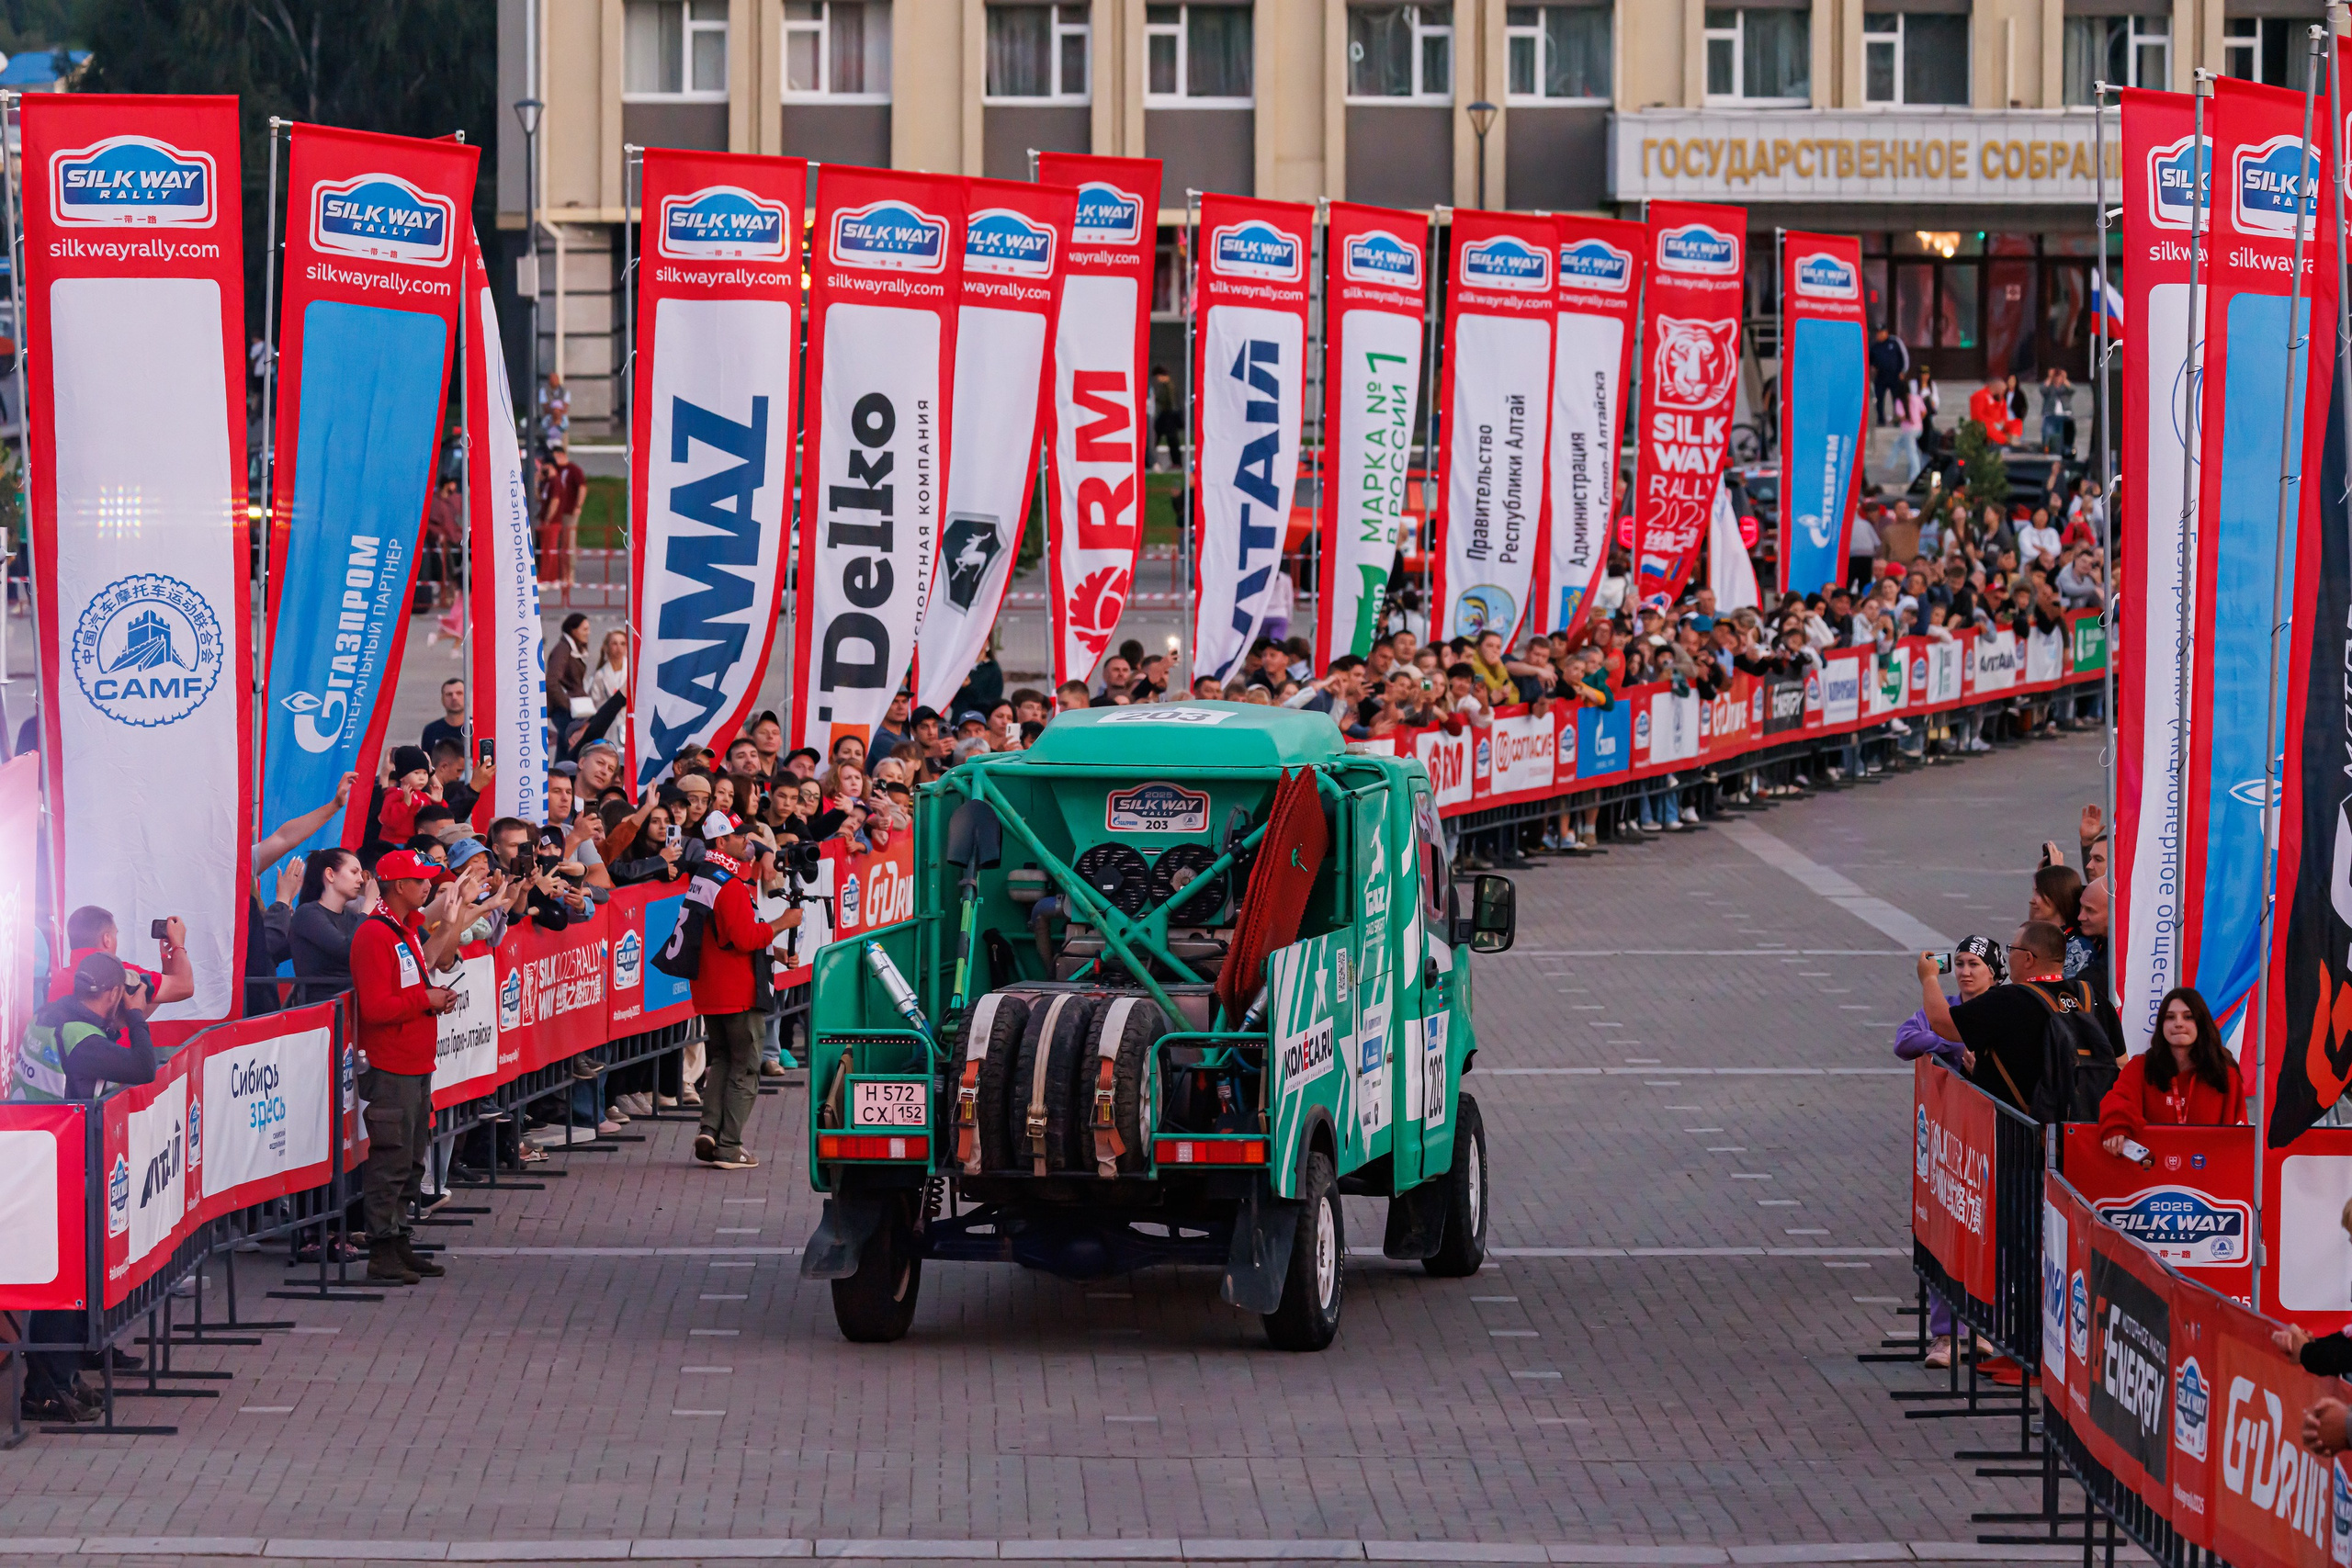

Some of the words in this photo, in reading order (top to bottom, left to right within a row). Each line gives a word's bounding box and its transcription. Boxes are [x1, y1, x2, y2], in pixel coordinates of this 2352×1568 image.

[1643, 138, 1968, 185] ГОСУДАРСТВЕННОЕ
[66, 170, 135, 188] SILK
[141, 170, 200, 189] WAY
[2245, 169, 2300, 195] SILK
[100, 190, 170, 199] RALLY
[113, 215, 157, 224] 一带一路
[325, 199, 385, 222] SILK
[389, 208, 440, 229] WAY
[671, 212, 727, 229] SILK
[731, 214, 777, 231] WAY
[1099, 205, 1134, 220] WAY
[353, 222, 411, 237] RALLY
[696, 229, 754, 239] RALLY
[842, 223, 893, 241] SILK
[896, 226, 937, 243] WAY
[967, 230, 1004, 247] ILK
[1006, 234, 1046, 251] WAY
[50, 239, 220, 261] silkwayrally.com
[865, 241, 914, 251] RALLY
[1222, 238, 1259, 253] SILK
[1261, 243, 1292, 258] WAY
[1352, 246, 1385, 261] SILK
[1385, 251, 1413, 265] WAY
[1667, 240, 1699, 253] SILK
[1701, 242, 1729, 255] WAY
[1069, 251, 1140, 266] wayrally.com
[1470, 253, 1504, 266] SILK
[1508, 256, 1543, 270] WAY
[1561, 254, 1590, 267] SILK
[1592, 258, 1623, 272] WAY
[306, 263, 450, 296] silkwayrally.com
[656, 267, 791, 287] silkwayrally.com
[827, 274, 944, 296] silkwayrally.com
[961, 281, 1051, 300] wayrally.com
[1209, 280, 1303, 301] silkwayrally.com
[1342, 287, 1423, 308] silkwayrally.com
[1457, 291, 1553, 310] silkwayrally.com
[1505, 395, 1525, 449] Алтай
[1653, 412, 1727, 445] SILK
[917, 400, 931, 515] КОМПАНИЯ
[1388, 384, 1407, 519] РОССИИ
[1653, 443, 1724, 474] WAY
[1360, 428, 1386, 543] МАРКА
[1466, 424, 1493, 561] Правительство
[1499, 456, 1526, 564] Республики
[1569, 432, 1591, 568] Администрация
[510, 468, 527, 621] «Газпромбанк»
[820, 392, 897, 692] Delko
[638, 395, 770, 787] KAMAZ
[327, 535, 380, 689] ГАЗПРОМ
[82, 583, 215, 665] 中国汽车摩托车运动联合会
[341, 621, 384, 750] ГЕНЕРАЛЬНЫЙ
[373, 538, 403, 616] ПАРТНЕР
[94, 678, 203, 700] CAMF
[514, 626, 535, 768] (Акционерное
[1115, 711, 1211, 722] 203
[1117, 799, 1159, 810] SILK
[1161, 799, 1199, 810] WAY
[1146, 819, 1169, 830] 203
[1366, 886, 1385, 918] GAZ
[538, 953, 557, 988] SILK
[575, 941, 602, 977] RALLY
[538, 987, 556, 1021] WAY
[231, 1058, 279, 1100] Сибирь
[1429, 1054, 1443, 1119] 203
[884, 1086, 914, 1101] 572
[250, 1095, 287, 1134] здесь
[898, 1106, 922, 1119] 152
[2150, 1201, 2193, 1213] 2025
[2110, 1214, 2174, 1232] SILK
[2177, 1214, 2234, 1232] WAY
